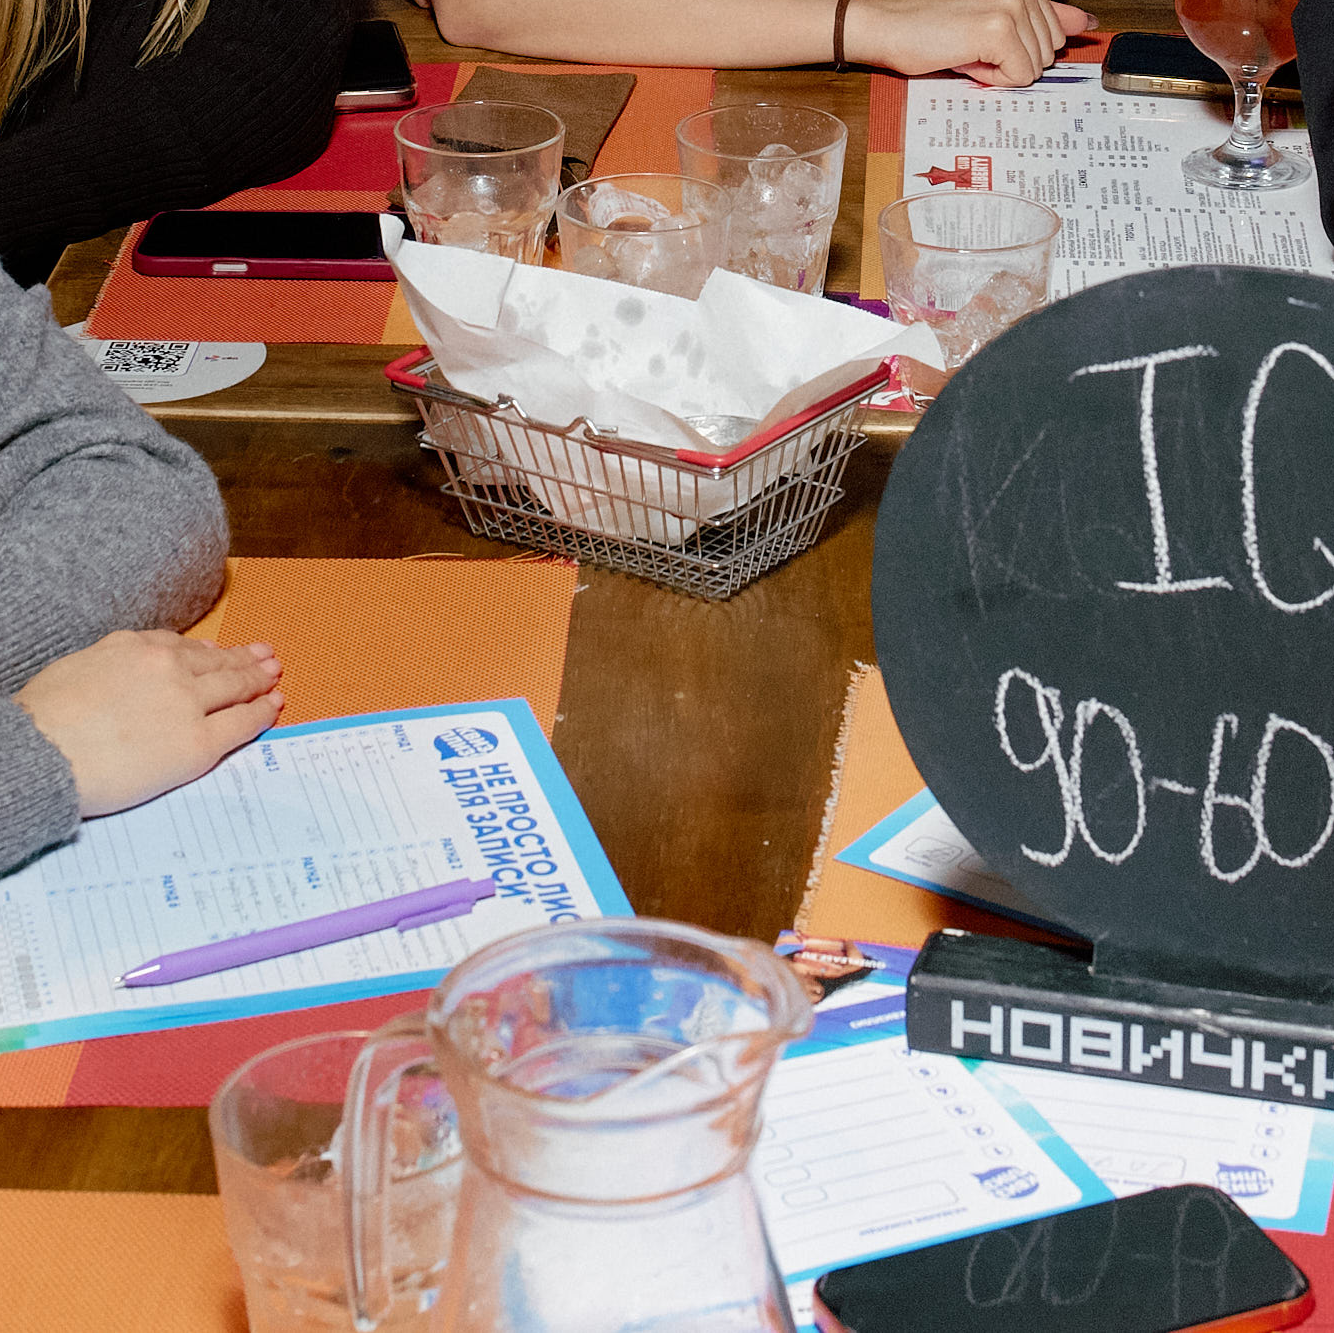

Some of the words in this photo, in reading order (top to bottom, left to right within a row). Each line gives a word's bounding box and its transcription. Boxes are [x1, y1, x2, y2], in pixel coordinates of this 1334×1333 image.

[970, 156, 989, 188] LIBERTY
[439, 768, 490, 808] ДЛЯ
[478, 762, 517, 787] НЕ
[492, 790, 558, 876] ПРОСТО
[534, 882, 582, 924] ЛИС
